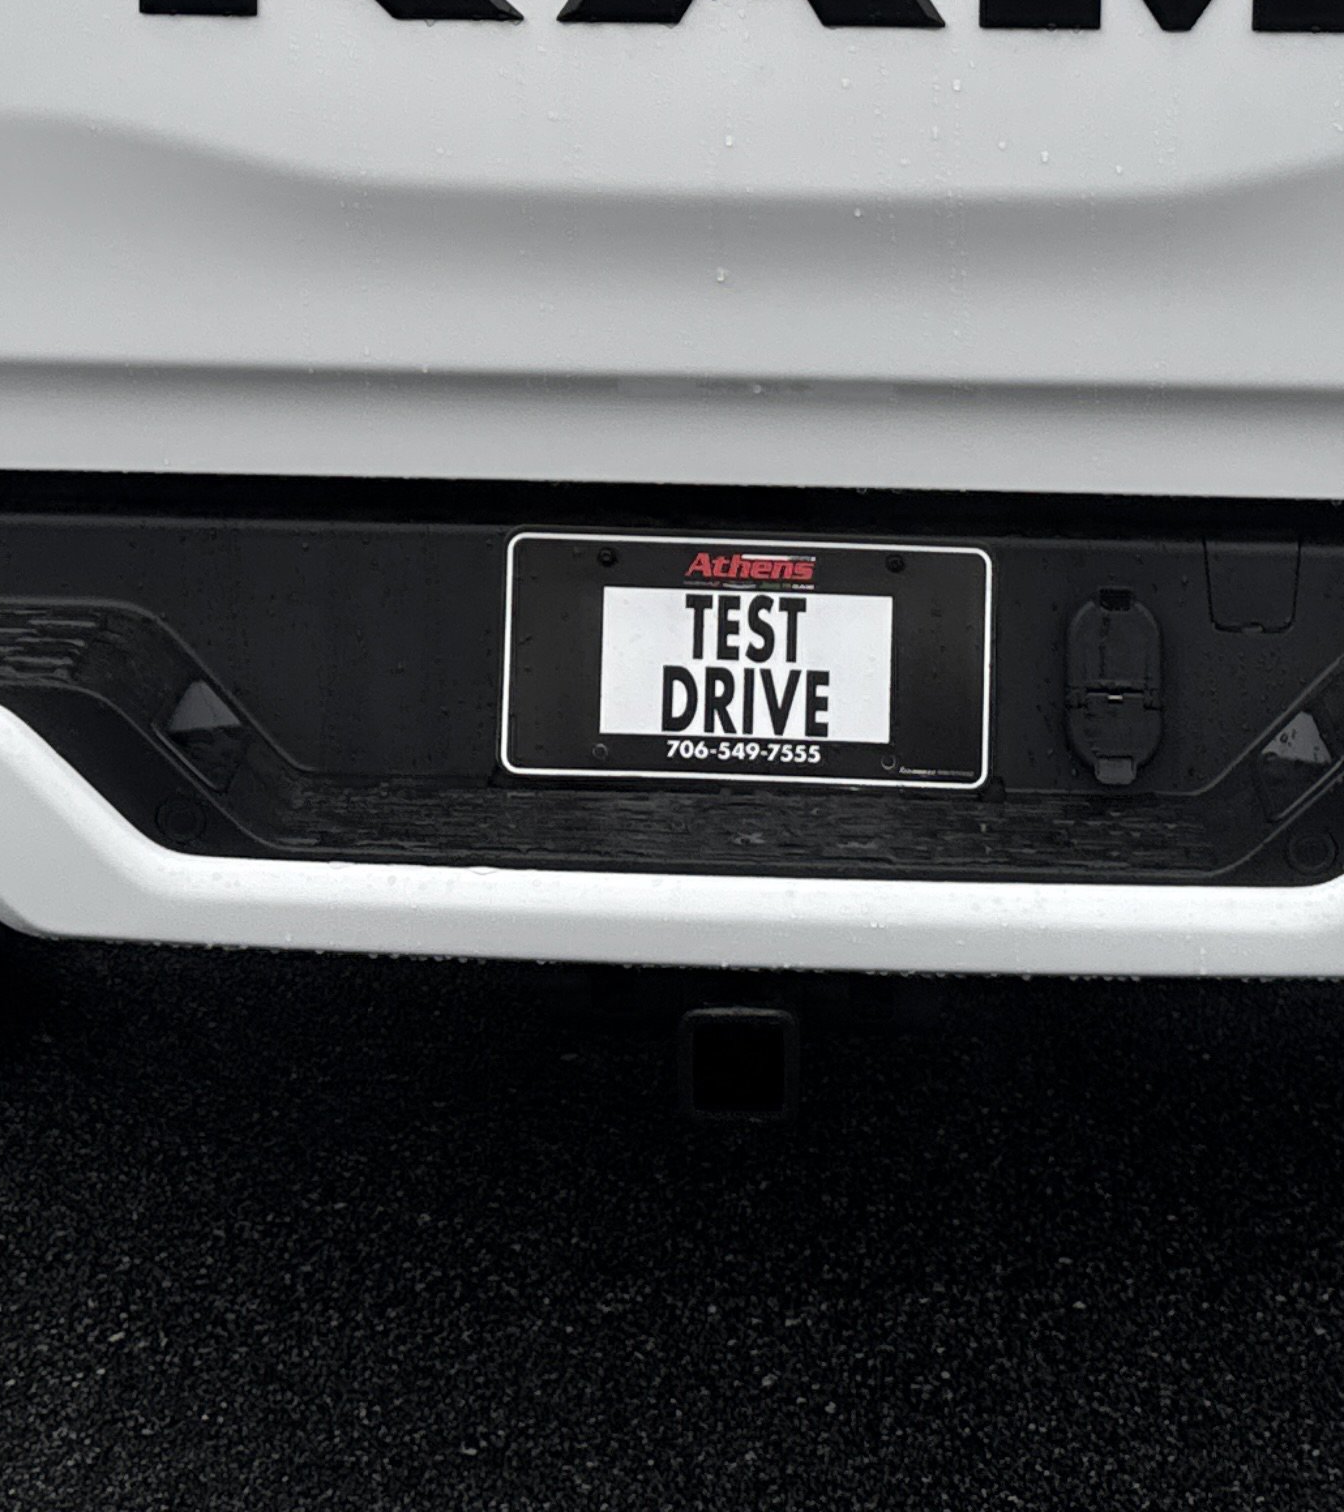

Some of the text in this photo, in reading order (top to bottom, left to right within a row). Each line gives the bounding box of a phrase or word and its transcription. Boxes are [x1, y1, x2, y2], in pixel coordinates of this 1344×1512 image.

[684, 552, 815, 581] Athens
[685, 593, 807, 663] TEST
[661, 664, 830, 738] DRIVE
[666, 739, 821, 764] 706-549-7555
